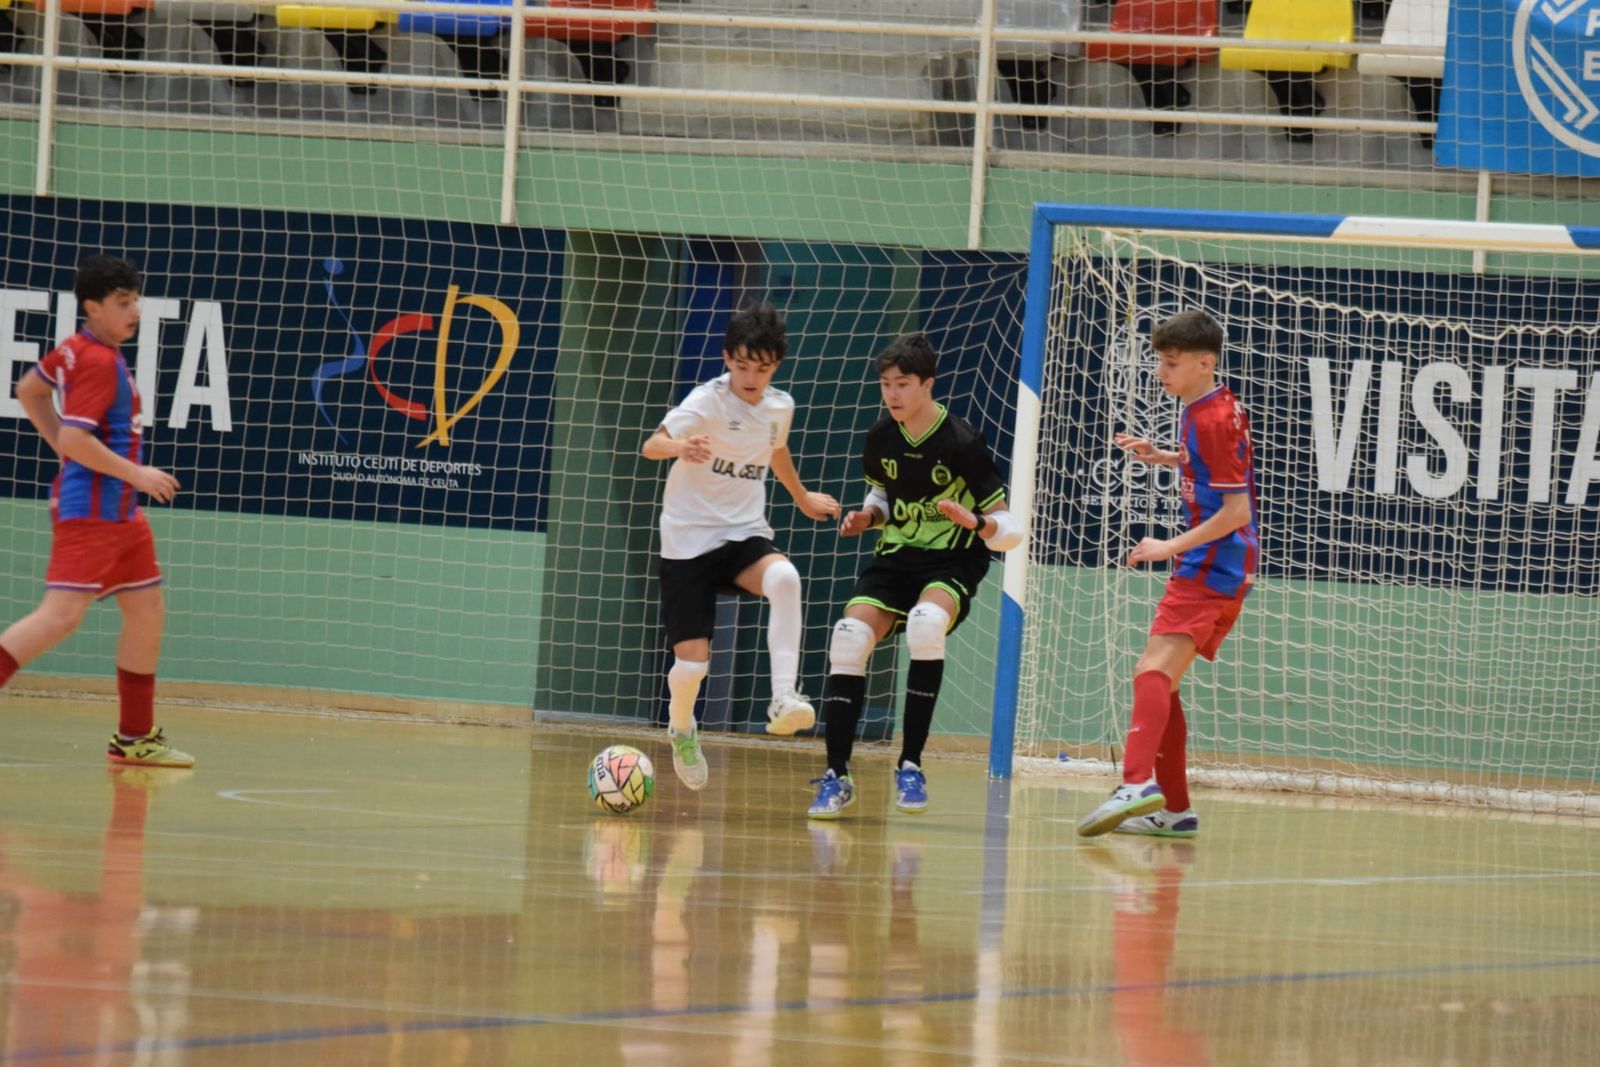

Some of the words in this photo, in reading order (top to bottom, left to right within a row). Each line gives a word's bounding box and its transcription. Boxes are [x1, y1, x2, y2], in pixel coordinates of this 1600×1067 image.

[298, 453, 361, 469] INSTITUTO
[401, 458, 417, 472] DE
[419, 460, 482, 476] DEPORTES
[331, 471, 365, 482] CIUDAD
[418, 477, 431, 488] DE
[431, 478, 459, 488] CEUTA
